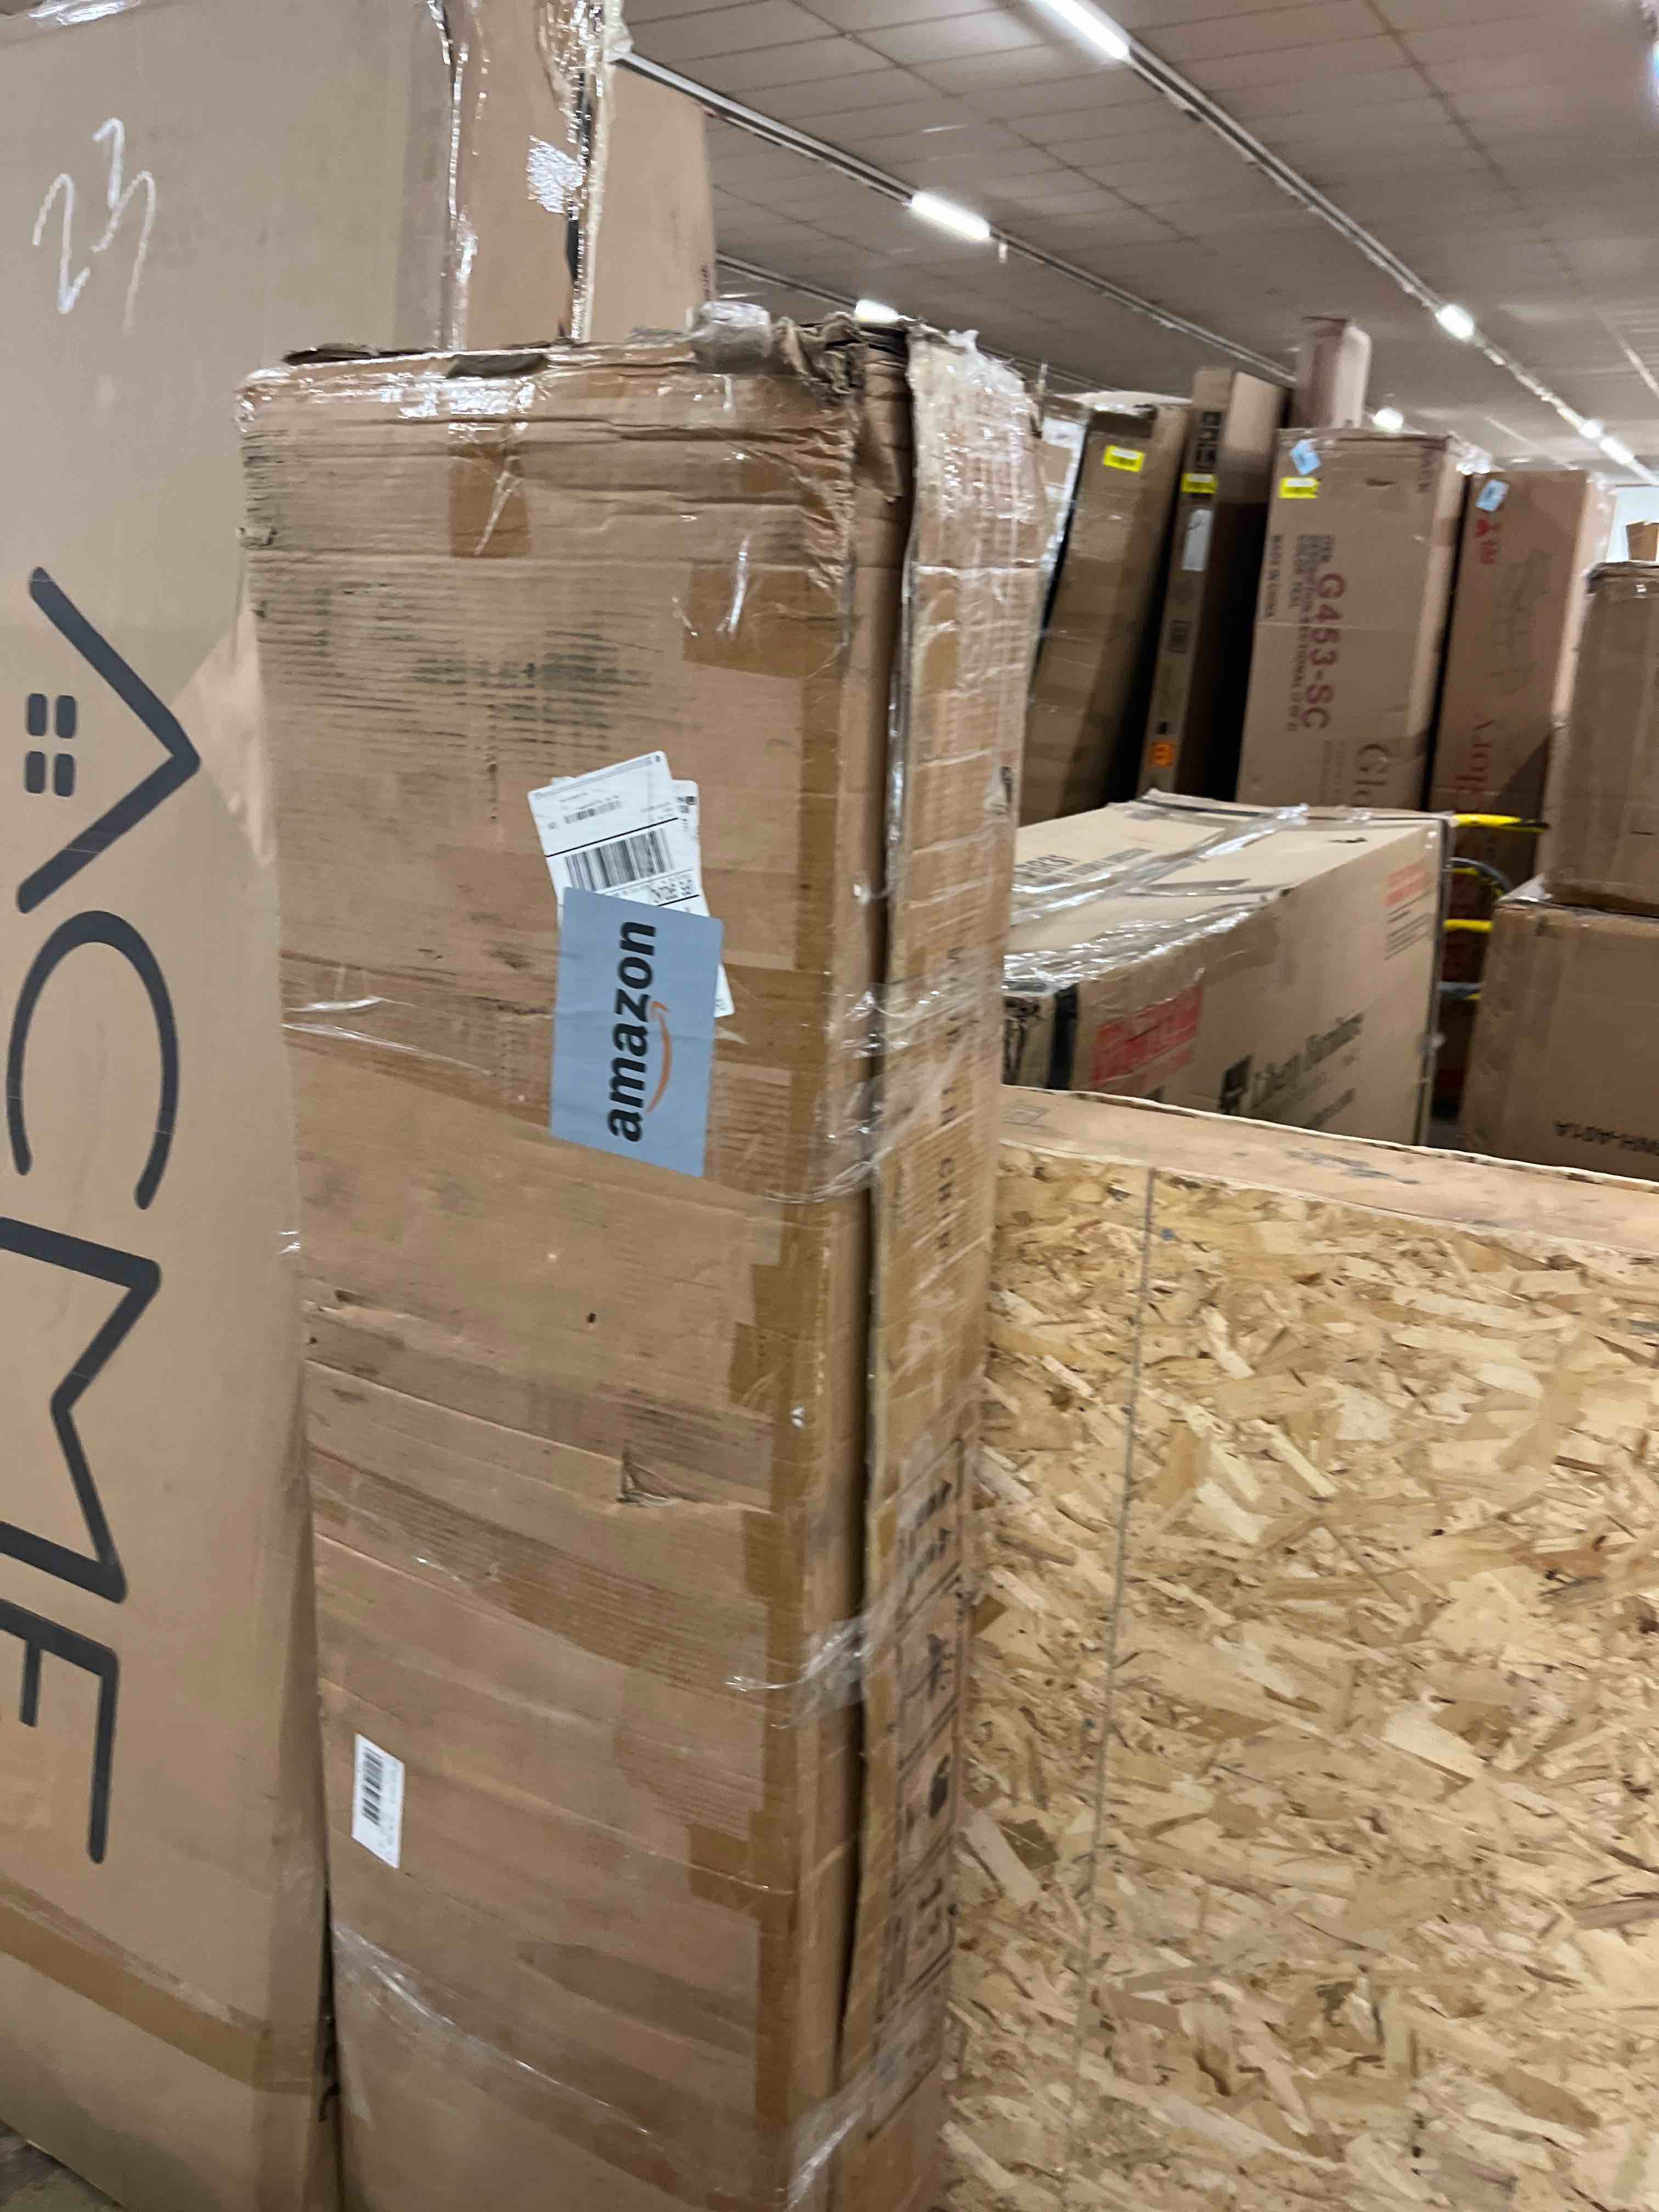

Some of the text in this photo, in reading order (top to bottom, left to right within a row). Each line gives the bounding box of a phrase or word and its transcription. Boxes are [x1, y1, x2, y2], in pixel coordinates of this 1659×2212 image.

[1301, 572, 1347, 730] G453-SC
[606, 921, 657, 1143] amazon
[0, 565, 201, 1865] ACME
